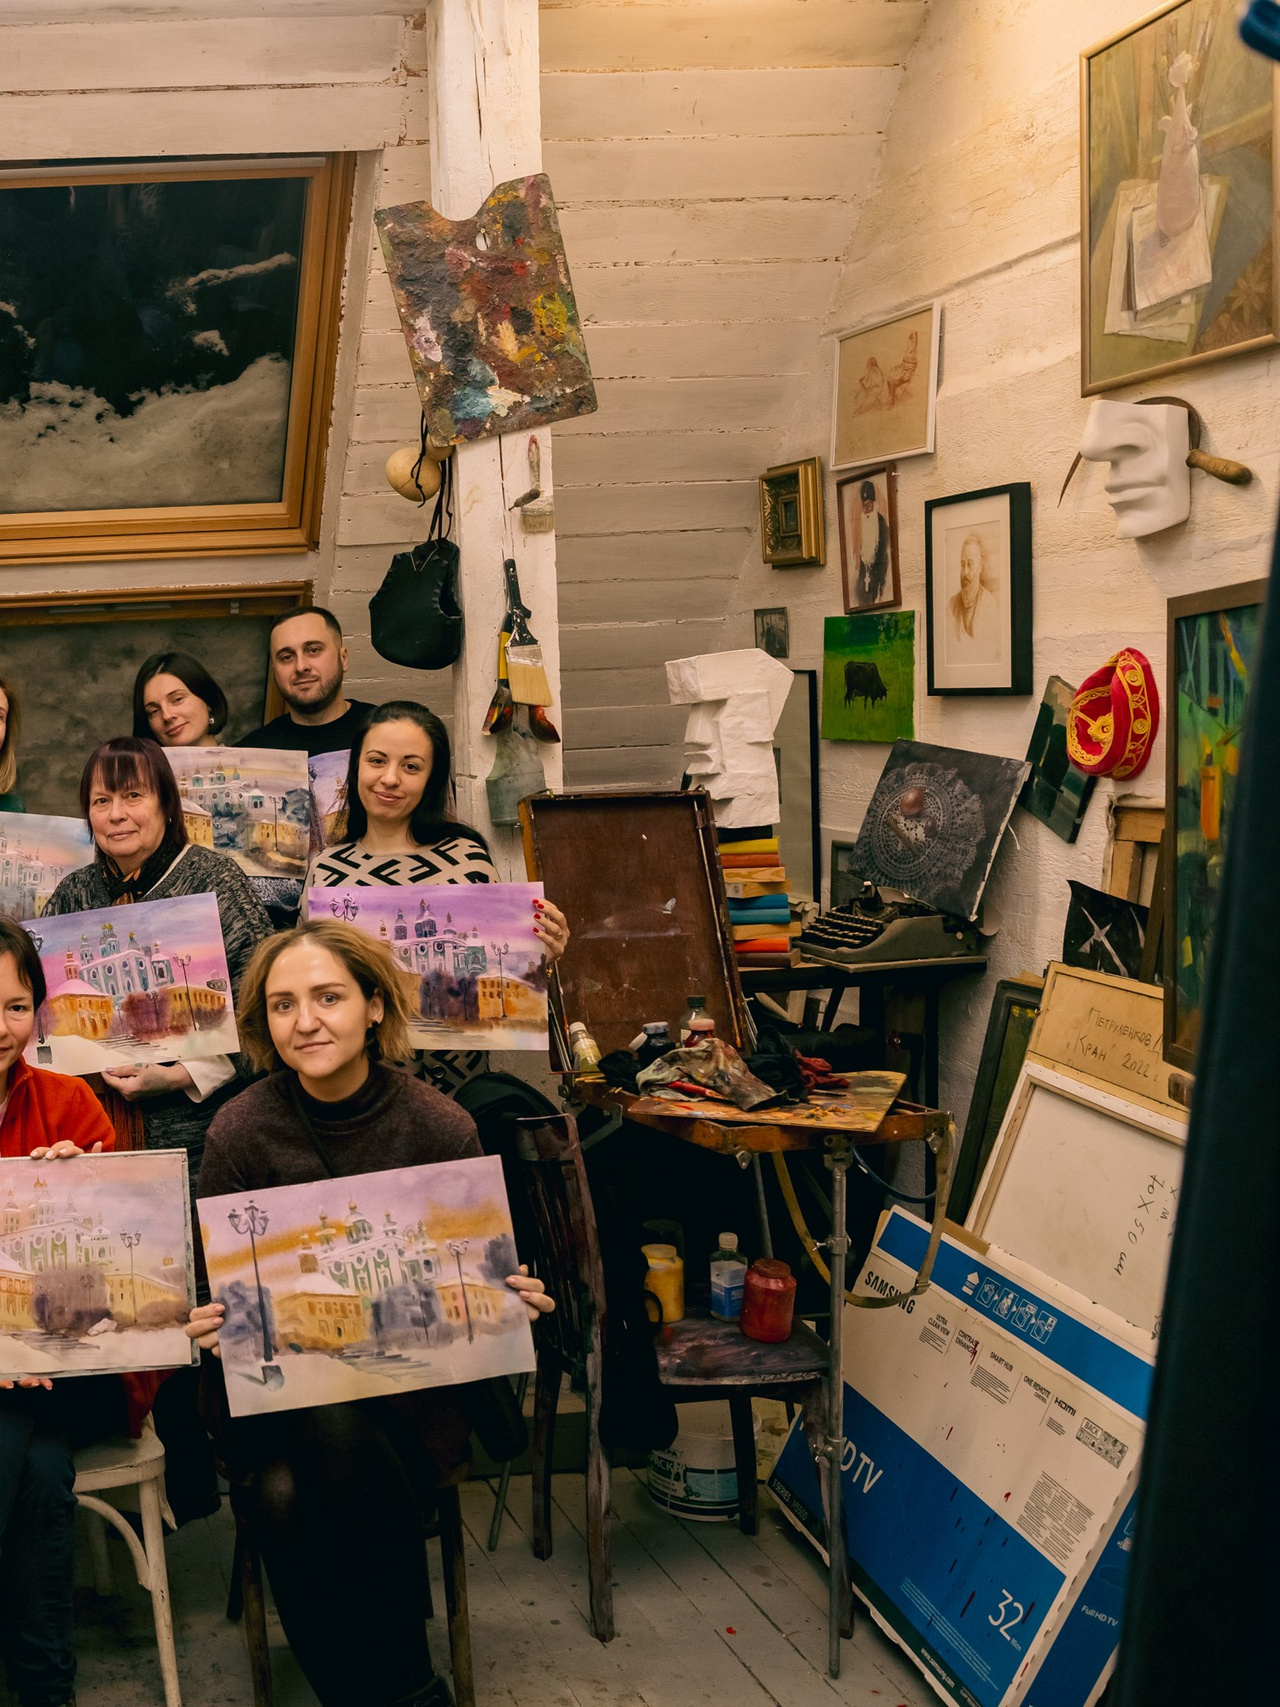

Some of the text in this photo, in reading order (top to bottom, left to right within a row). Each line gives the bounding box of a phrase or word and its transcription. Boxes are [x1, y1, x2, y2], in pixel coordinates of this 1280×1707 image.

[864, 1271, 916, 1314] SAMSNG
[989, 1351, 1006, 1367] SMART
[1033, 1381, 1052, 1398] REMOTE
[1084, 1421, 1100, 1437] BACK
[852, 1452, 883, 1494] TV
[988, 1588, 1024, 1641] 32
[1081, 1605, 1119, 1627] Full HD TV
